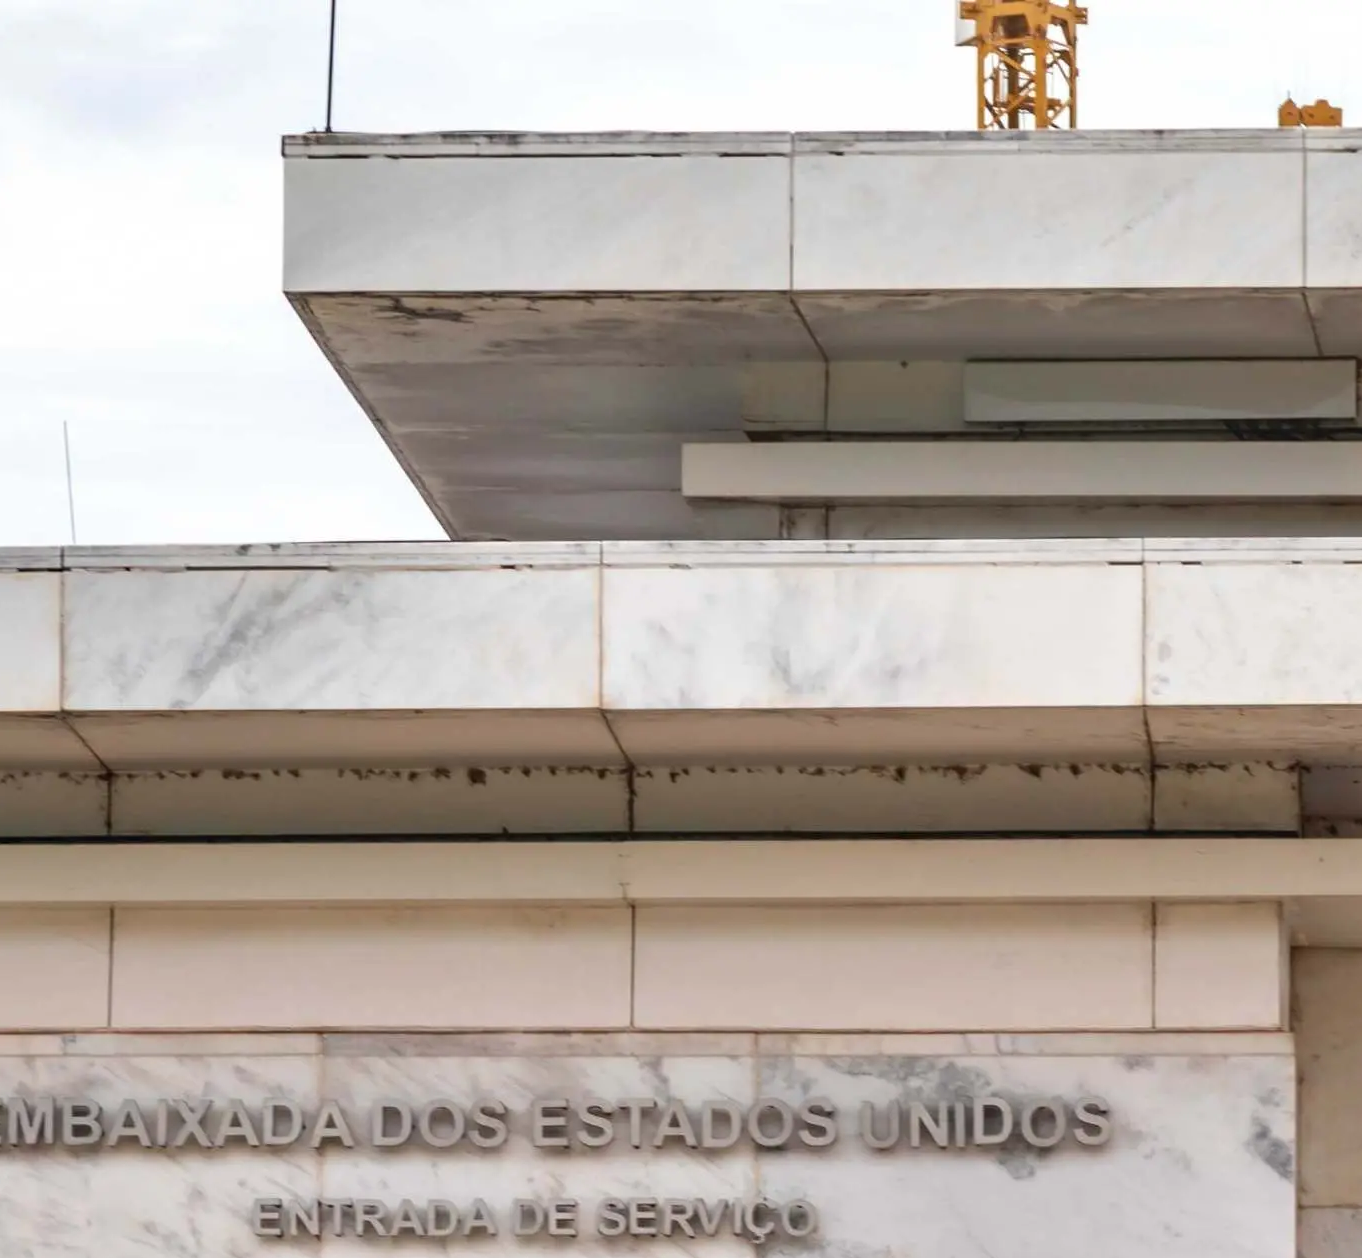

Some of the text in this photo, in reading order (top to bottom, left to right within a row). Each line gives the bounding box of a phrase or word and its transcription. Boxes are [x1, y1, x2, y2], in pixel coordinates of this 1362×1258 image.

[372, 1097, 509, 1149] DOS
[534, 1097, 837, 1149] ESTADOS
[859, 1096, 1112, 1149] UNIDOS
[252, 1198, 818, 1244] ENTRADA DE SERVIÇO
